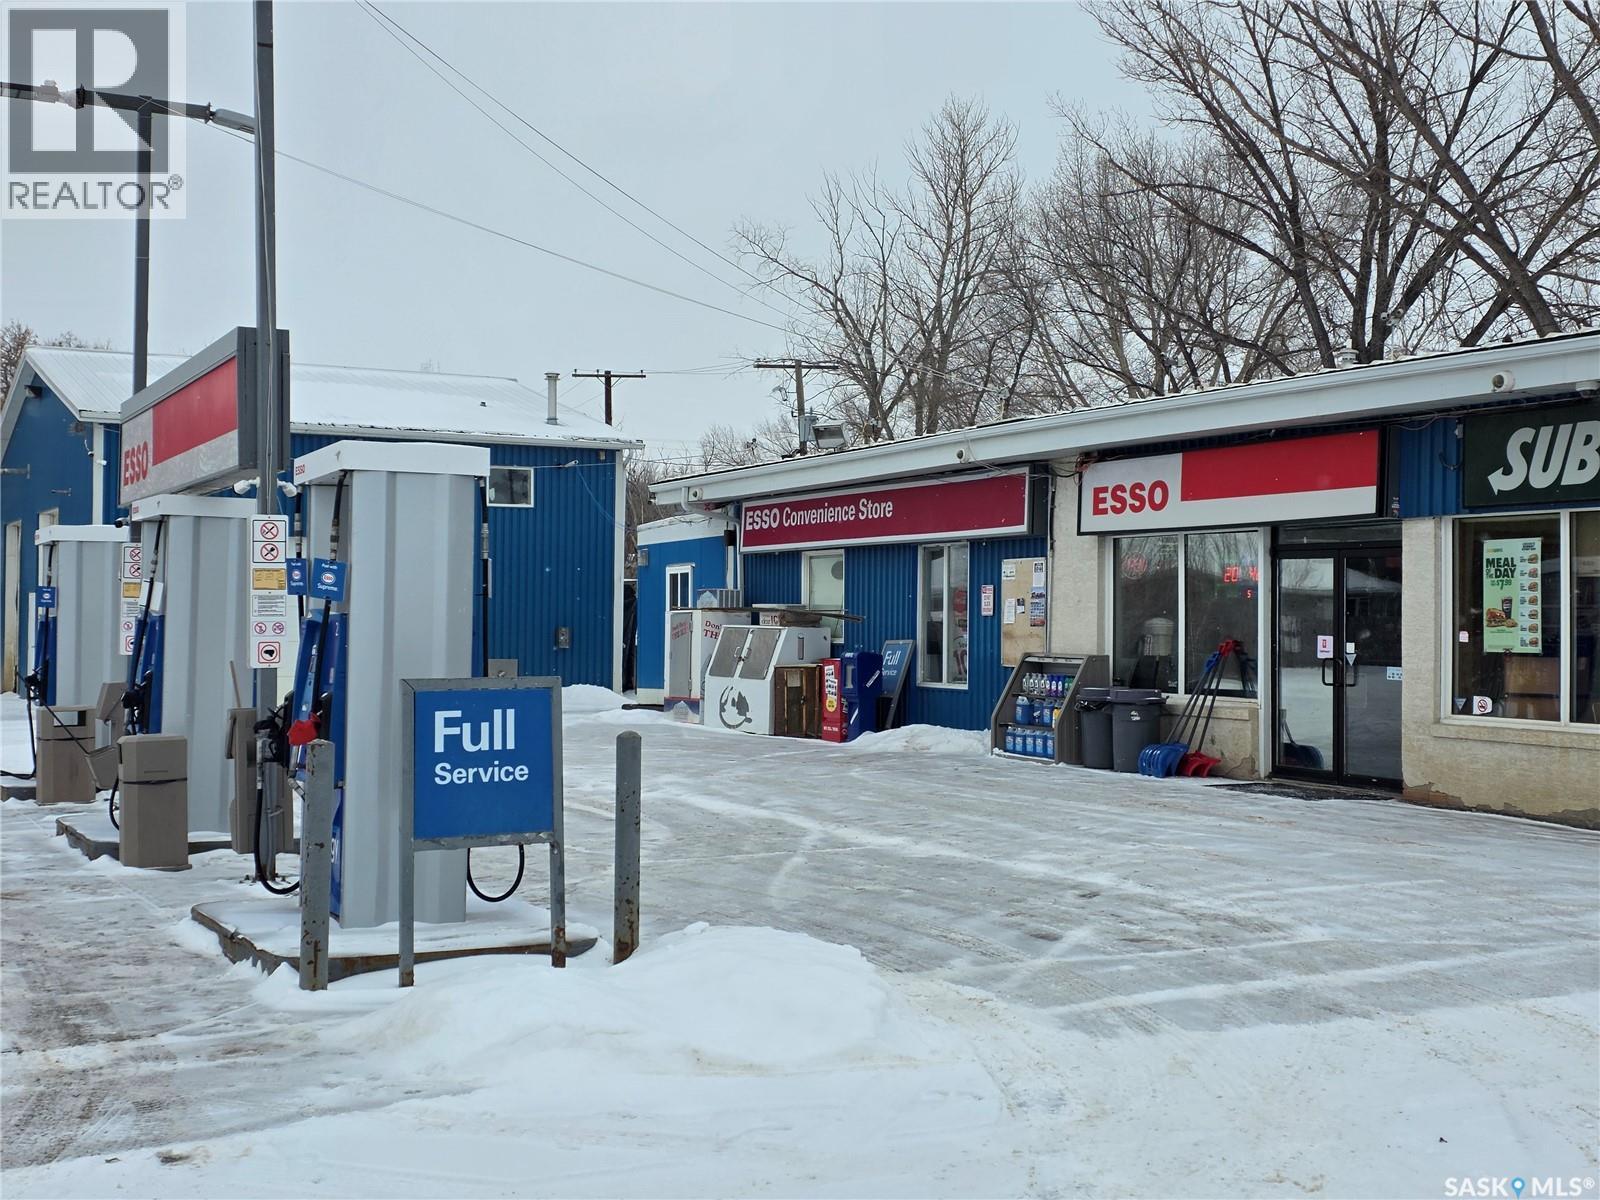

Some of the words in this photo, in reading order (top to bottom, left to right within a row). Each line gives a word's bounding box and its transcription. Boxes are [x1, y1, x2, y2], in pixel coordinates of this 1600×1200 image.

[122, 440, 149, 487] ESSO
[295, 464, 306, 476] ESSO
[1092, 480, 1169, 516] ESSO
[745, 508, 780, 531] ESSO
[782, 502, 856, 527] Convenience
[858, 498, 893, 520] Store
[1485, 557, 1517, 569] MEAL
[1494, 567, 1517, 579] DAY
[883, 650, 901, 666] Full
[434, 708, 516, 753] Full
[434, 760, 529, 785] Service
